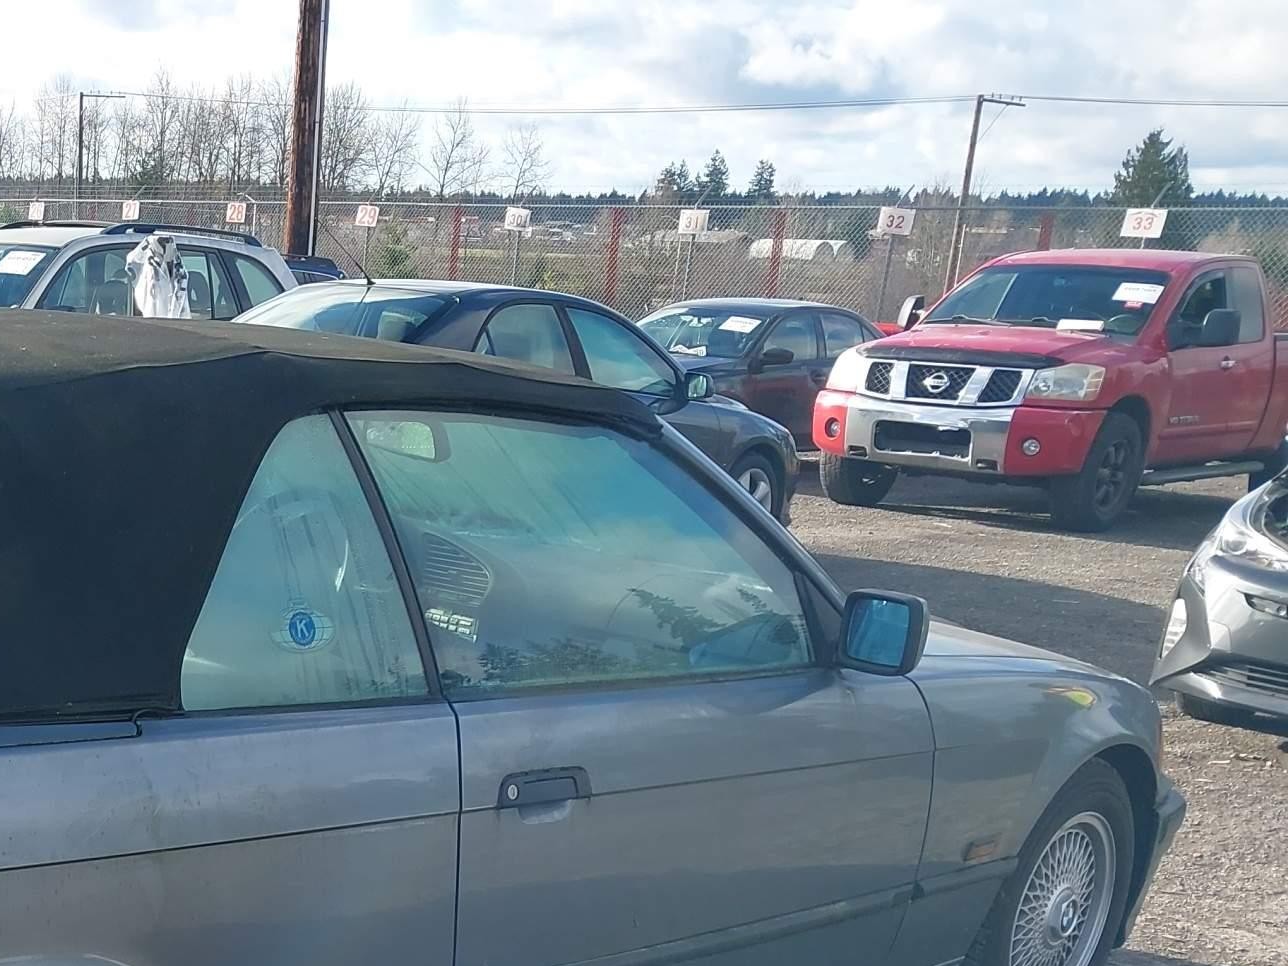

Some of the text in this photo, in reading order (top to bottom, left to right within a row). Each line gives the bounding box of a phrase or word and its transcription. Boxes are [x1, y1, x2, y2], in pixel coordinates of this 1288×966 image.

[124, 202, 137, 218] 27
[228, 203, 244, 221] 28
[357, 207, 377, 226] 29
[509, 213, 523, 225] 30
[684, 214, 700, 229] 31
[886, 214, 905, 229] 32
[1132, 216, 1154, 230] 33
